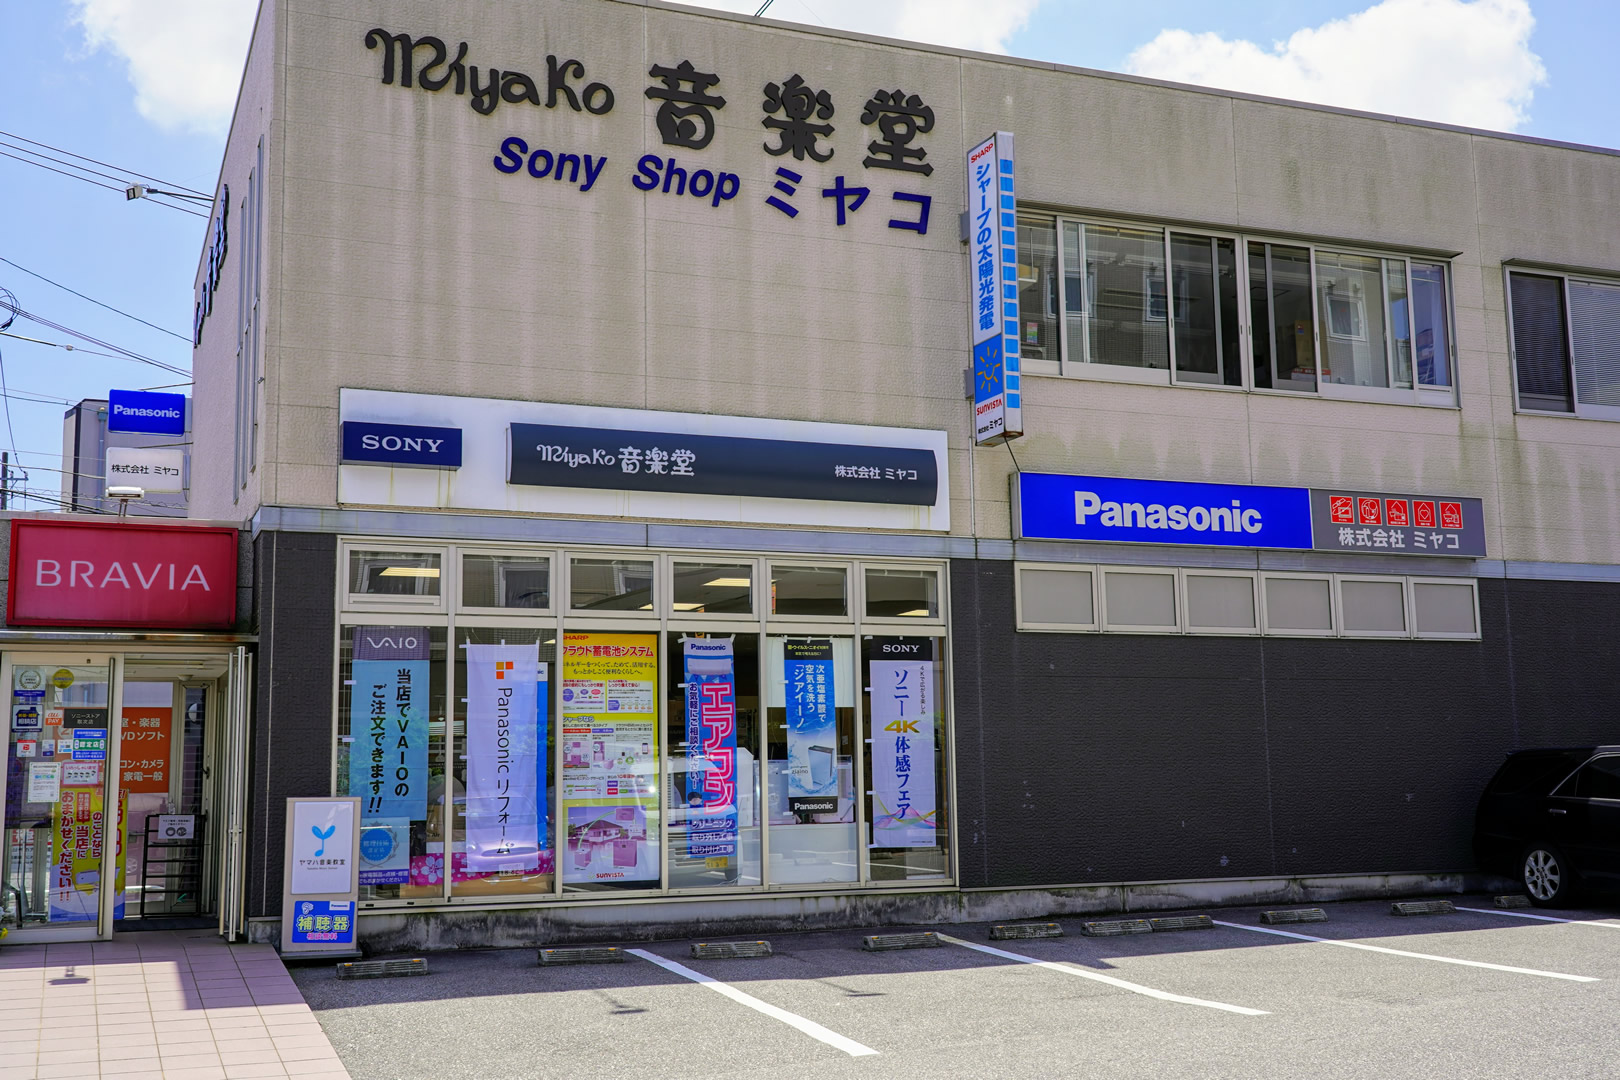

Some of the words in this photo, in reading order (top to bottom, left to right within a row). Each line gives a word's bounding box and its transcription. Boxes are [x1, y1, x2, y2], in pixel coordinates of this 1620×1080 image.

[644, 59, 935, 176] 音楽堂
[970, 143, 994, 164] SHARP
[493, 137, 607, 192] Sony
[631, 154, 740, 207] Shop
[765, 166, 932, 234] ミヤコ
[976, 163, 995, 331] シャープの太陽光発電
[113, 404, 181, 419] Panasonic
[989, 417, 1003, 430] ミヤコ
[361, 434, 444, 454] SONY
[111, 464, 150, 476] 株式会社
[153, 466, 180, 476] ミヤコ
[618, 446, 695, 477] 音楽堂
[834, 464, 881, 480] 株式会社
[884, 467, 918, 481] ミヤコ
[1074, 490, 1263, 534] Panasonic
[1338, 526, 1405, 548] 株式会社
[1413, 530, 1460, 551] ミヤコ
[35, 559, 211, 592] BRAVIA
[367, 637, 418, 649] VAIO
[690, 643, 726, 651] Panasonic
[882, 645, 920, 653] SONY
[805, 664, 816, 713] 空気を洗う
[816, 664, 827, 723] 次亜塩素酸で
[395, 668, 412, 797] 当店でVAIOの
[497, 687, 514, 774] Panasonic
[701, 682, 735, 815] エアコン
[124, 772, 163, 781] 家電一般
[794, 801, 834, 811] Panasonic
[75, 825, 89, 858] 当店に
[299, 858, 346, 866] ヤマハ音楽教室
[297, 915, 350, 932] 補聴器
